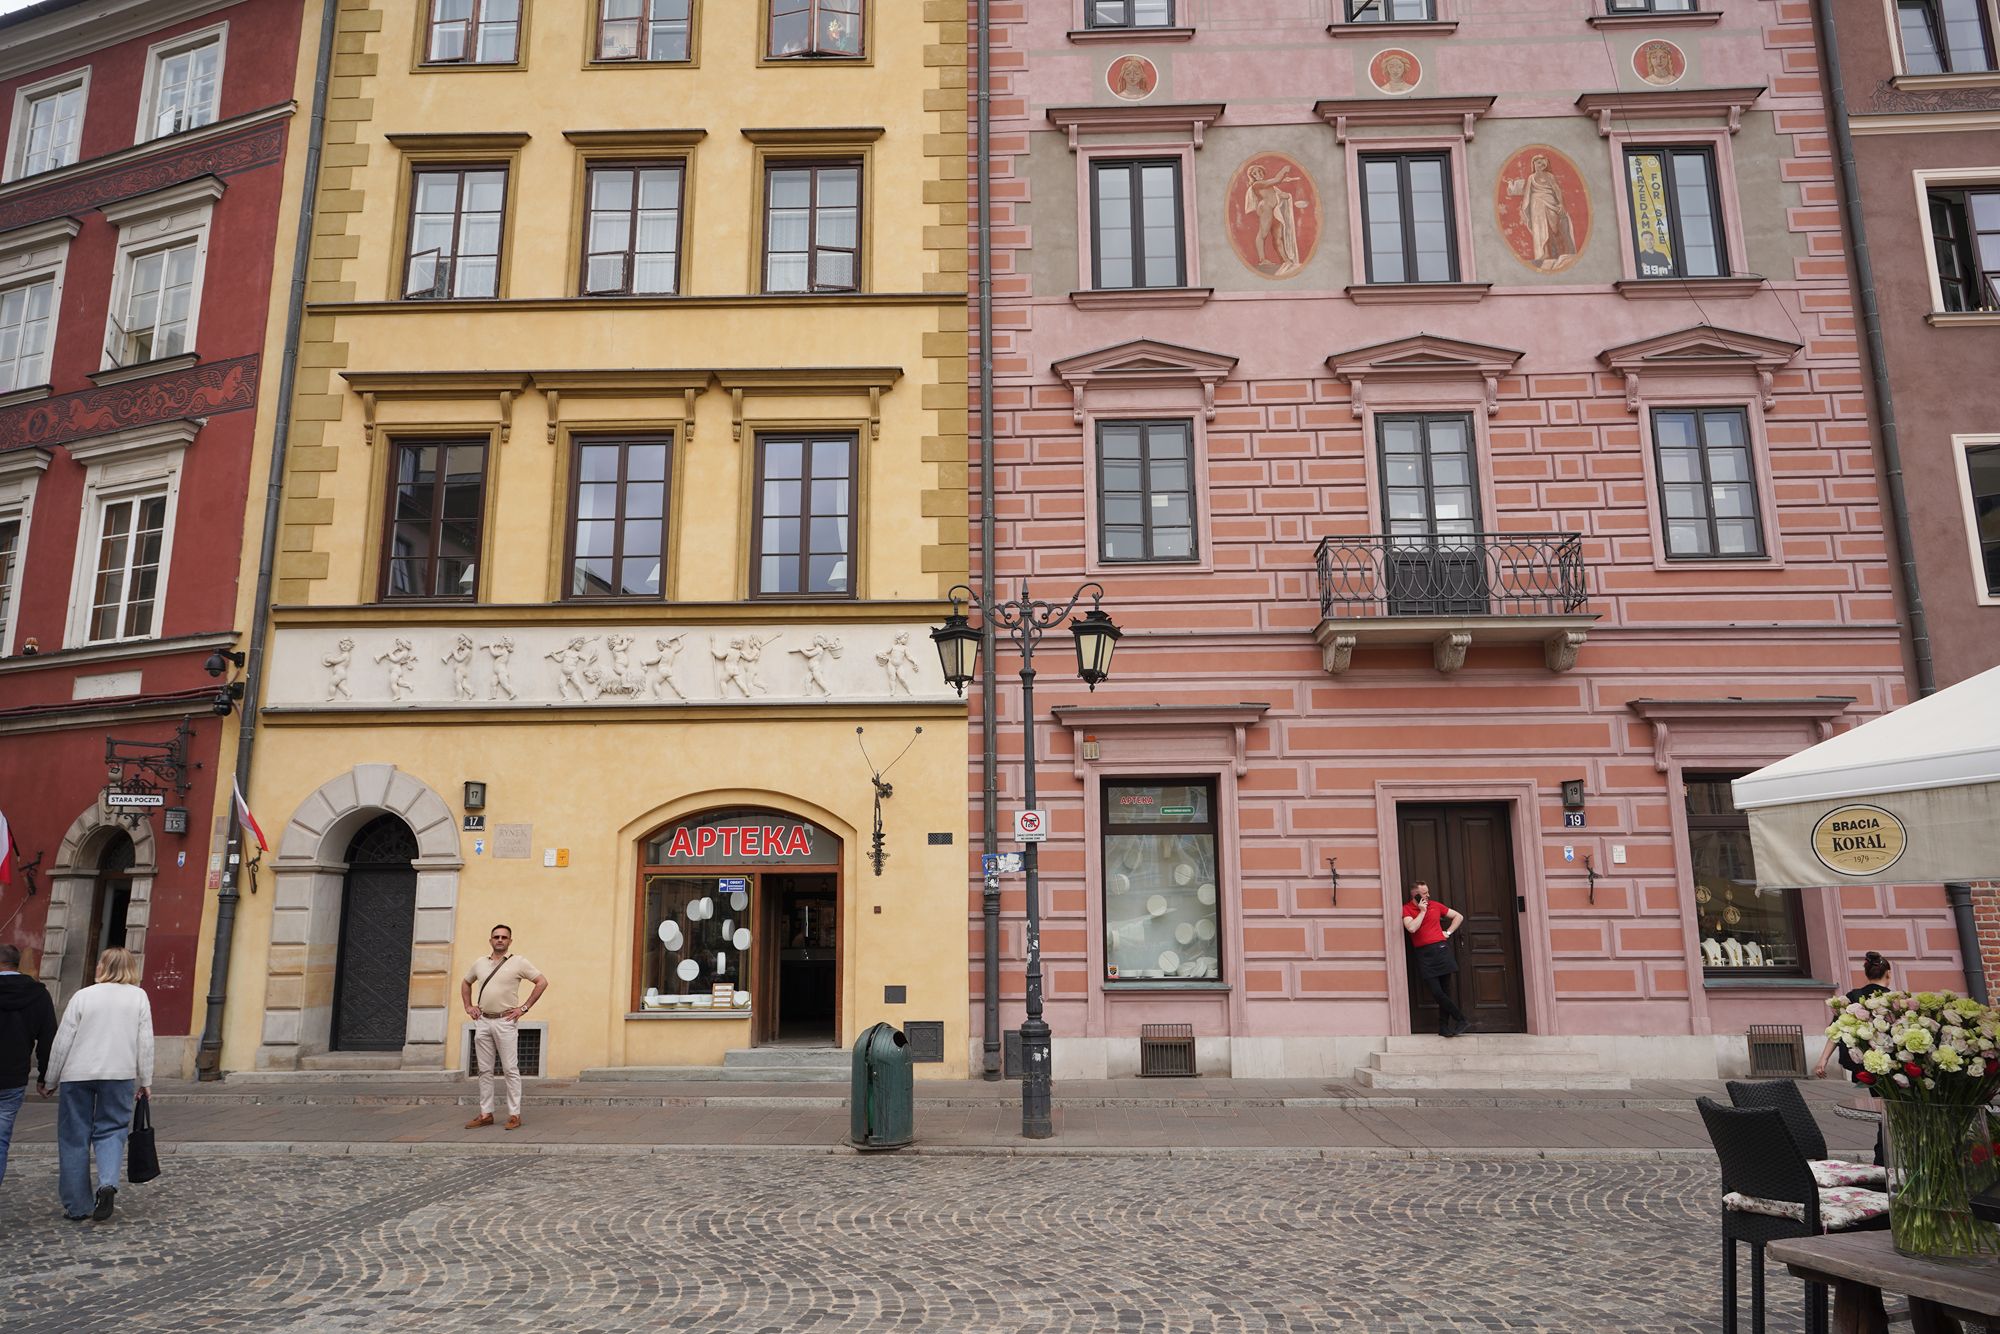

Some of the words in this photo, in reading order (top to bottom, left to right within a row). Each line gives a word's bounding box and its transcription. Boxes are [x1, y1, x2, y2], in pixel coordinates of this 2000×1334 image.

[1651, 173, 1660, 199] FOR
[1635, 158, 1650, 229] SPRZEDAM
[1655, 209, 1666, 244] SALE
[471, 791, 479, 799] 17
[1570, 787, 1578, 796] 19
[1120, 795, 1153, 805] APTEKA
[170, 820, 181, 829] 15
[469, 816, 479, 826] 17
[1570, 814, 1582, 826] 19
[1832, 818, 1880, 832] BRACIA
[668, 826, 811, 857] APTEKA
[1832, 833, 1886, 852] KORAL
[1854, 855, 1870, 864] 1979
